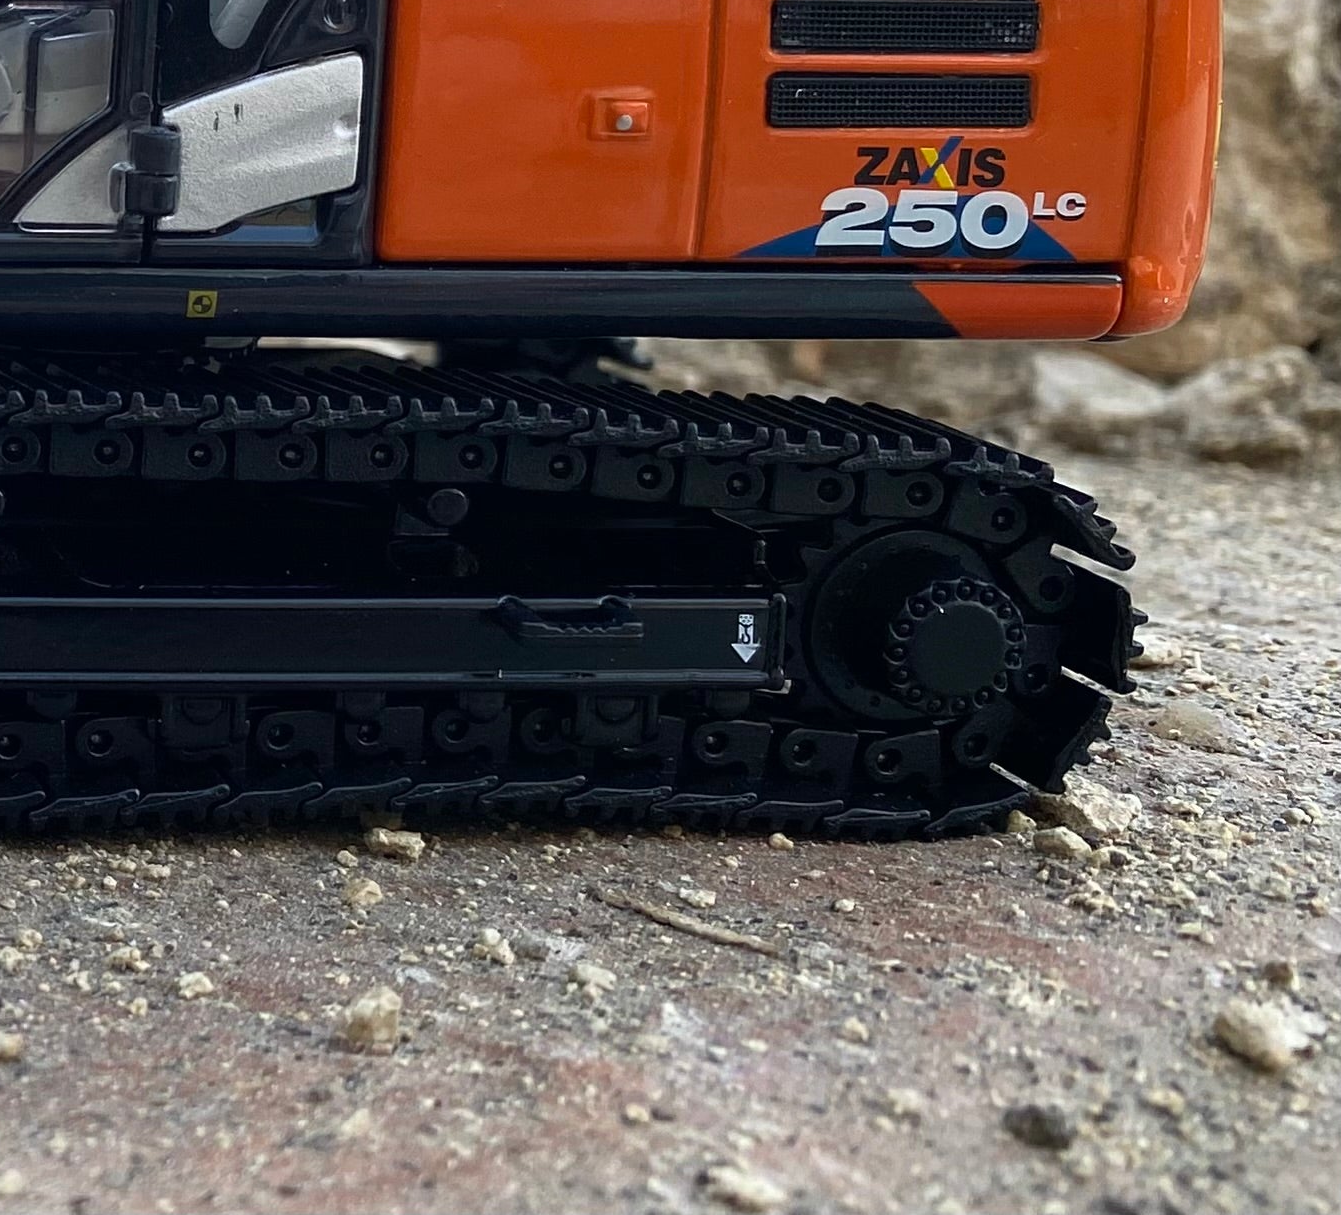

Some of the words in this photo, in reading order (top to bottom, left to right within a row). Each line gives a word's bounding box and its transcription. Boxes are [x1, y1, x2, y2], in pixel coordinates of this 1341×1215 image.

[853, 136, 1007, 188] ZAXIS
[815, 187, 1029, 253] 250
[1032, 191, 1087, 219] LC
